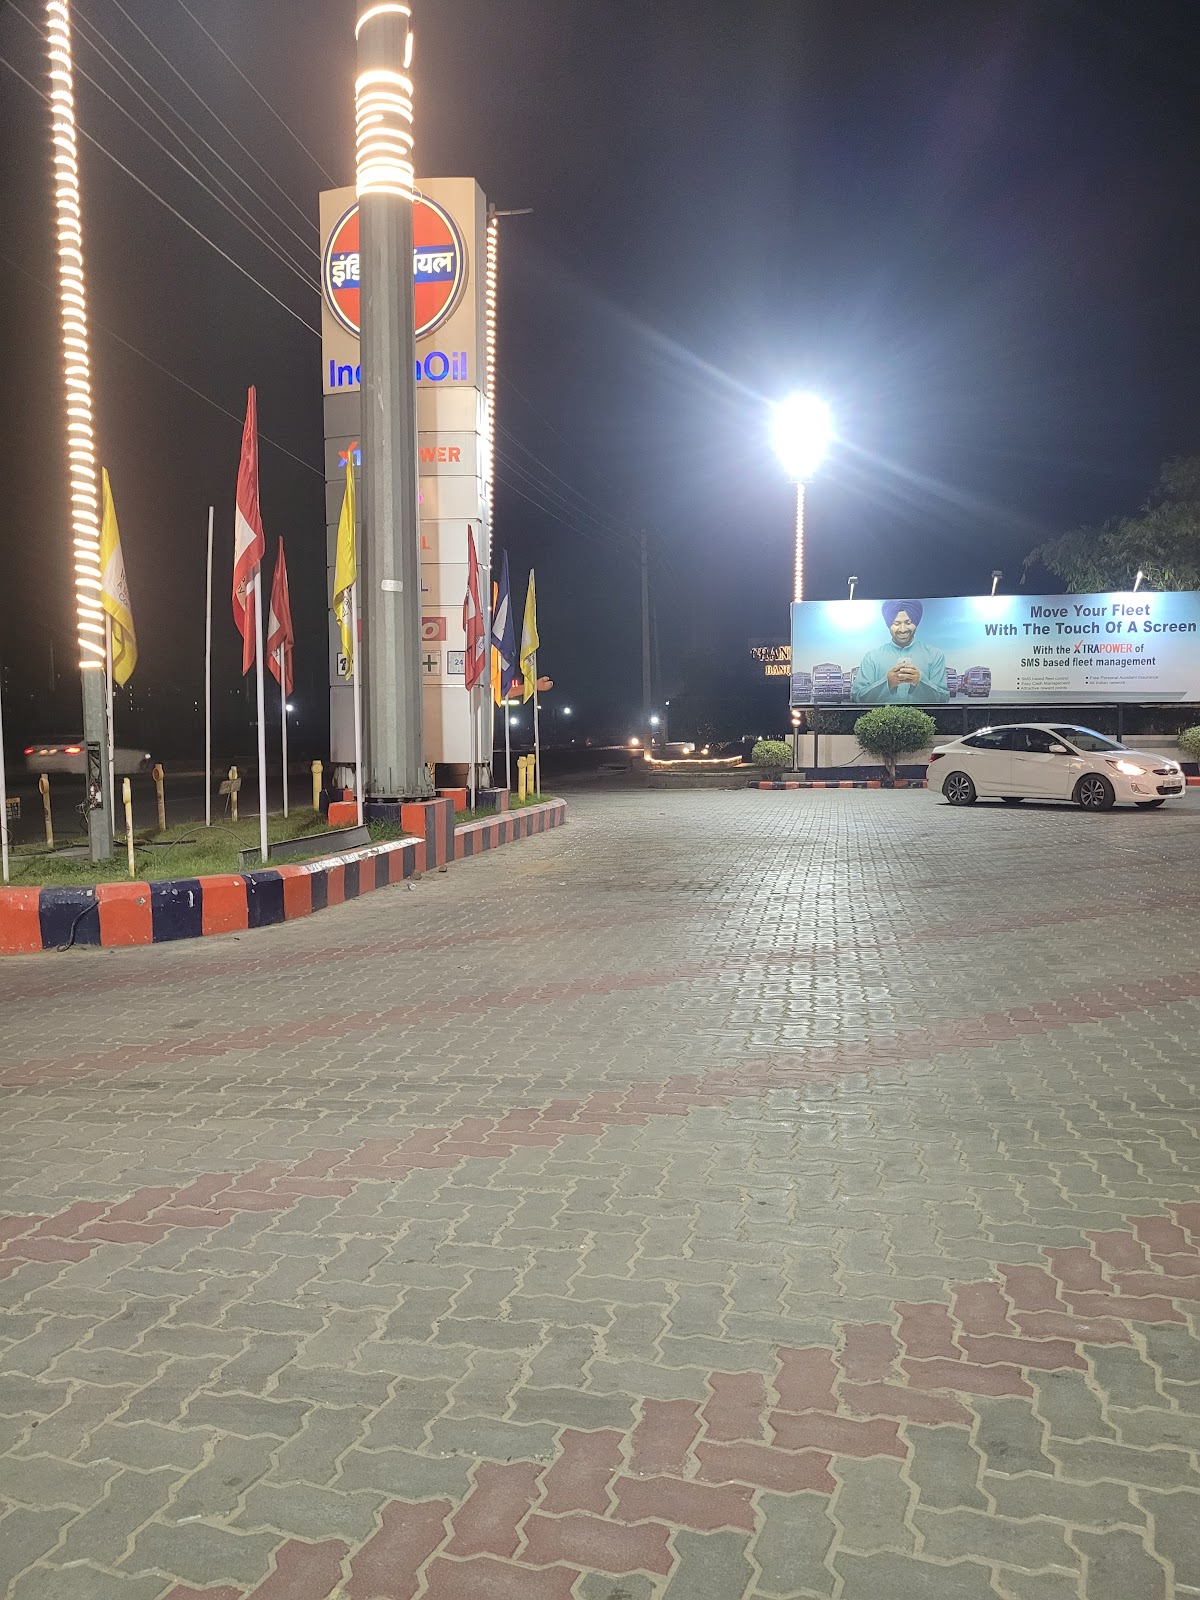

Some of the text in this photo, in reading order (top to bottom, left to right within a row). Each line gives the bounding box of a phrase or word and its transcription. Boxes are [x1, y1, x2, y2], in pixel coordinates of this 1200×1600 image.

[1030, 604, 1150, 618] Move Your Fleet
[985, 620, 1197, 636] With The Touch Of A Screen
[1033, 640, 1145, 655] With the XTRAPOWER of
[1020, 657, 1156, 668] SMS based fleet management
